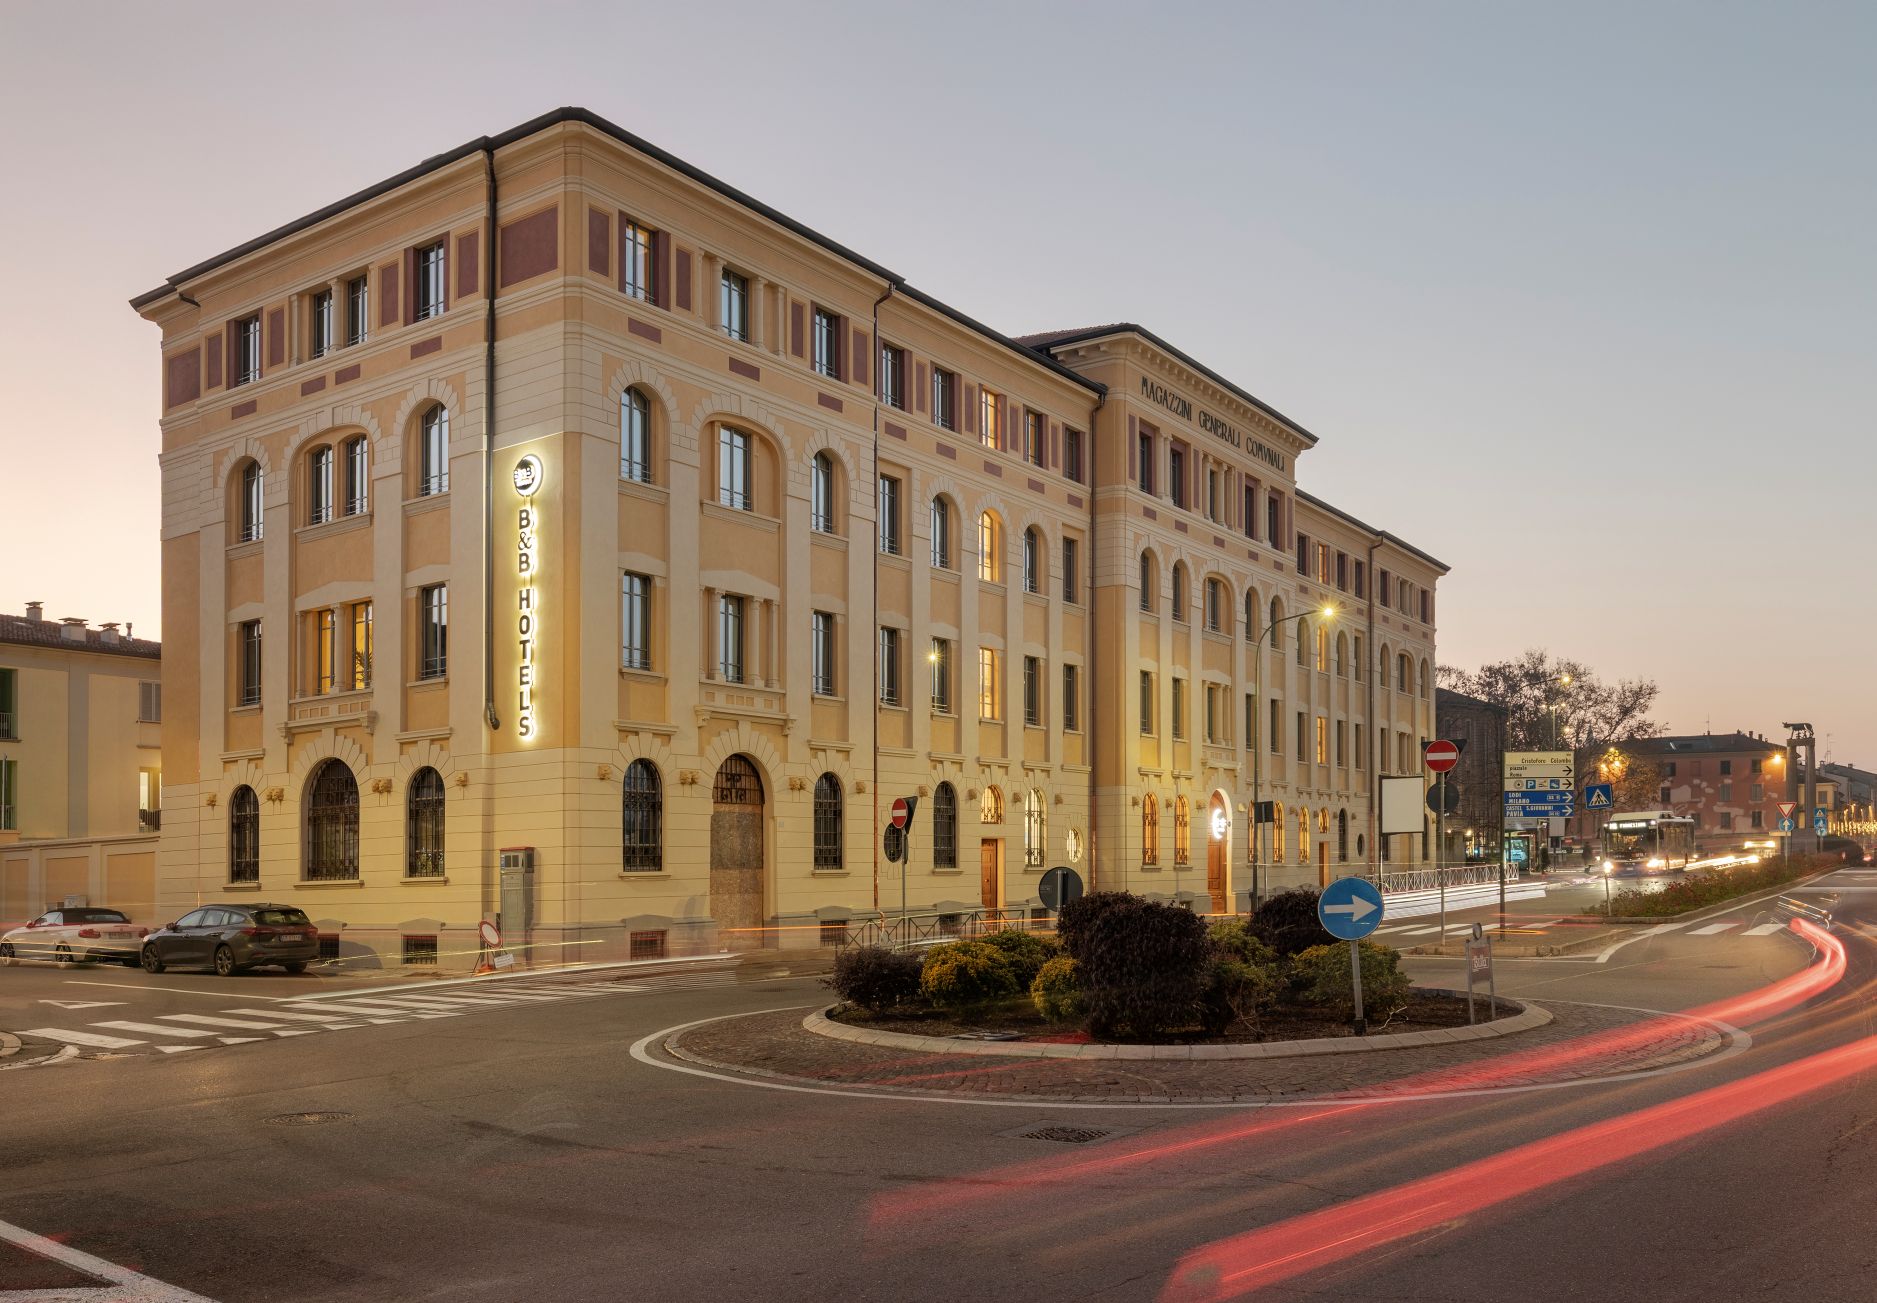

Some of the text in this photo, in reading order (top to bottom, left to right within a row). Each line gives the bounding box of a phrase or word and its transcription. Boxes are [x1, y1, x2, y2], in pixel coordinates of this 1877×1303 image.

[1141, 376, 1192, 422] MAGAZZINI
[1198, 410, 1241, 449] GENERALI
[518, 509, 533, 737] B&B HOTELS
